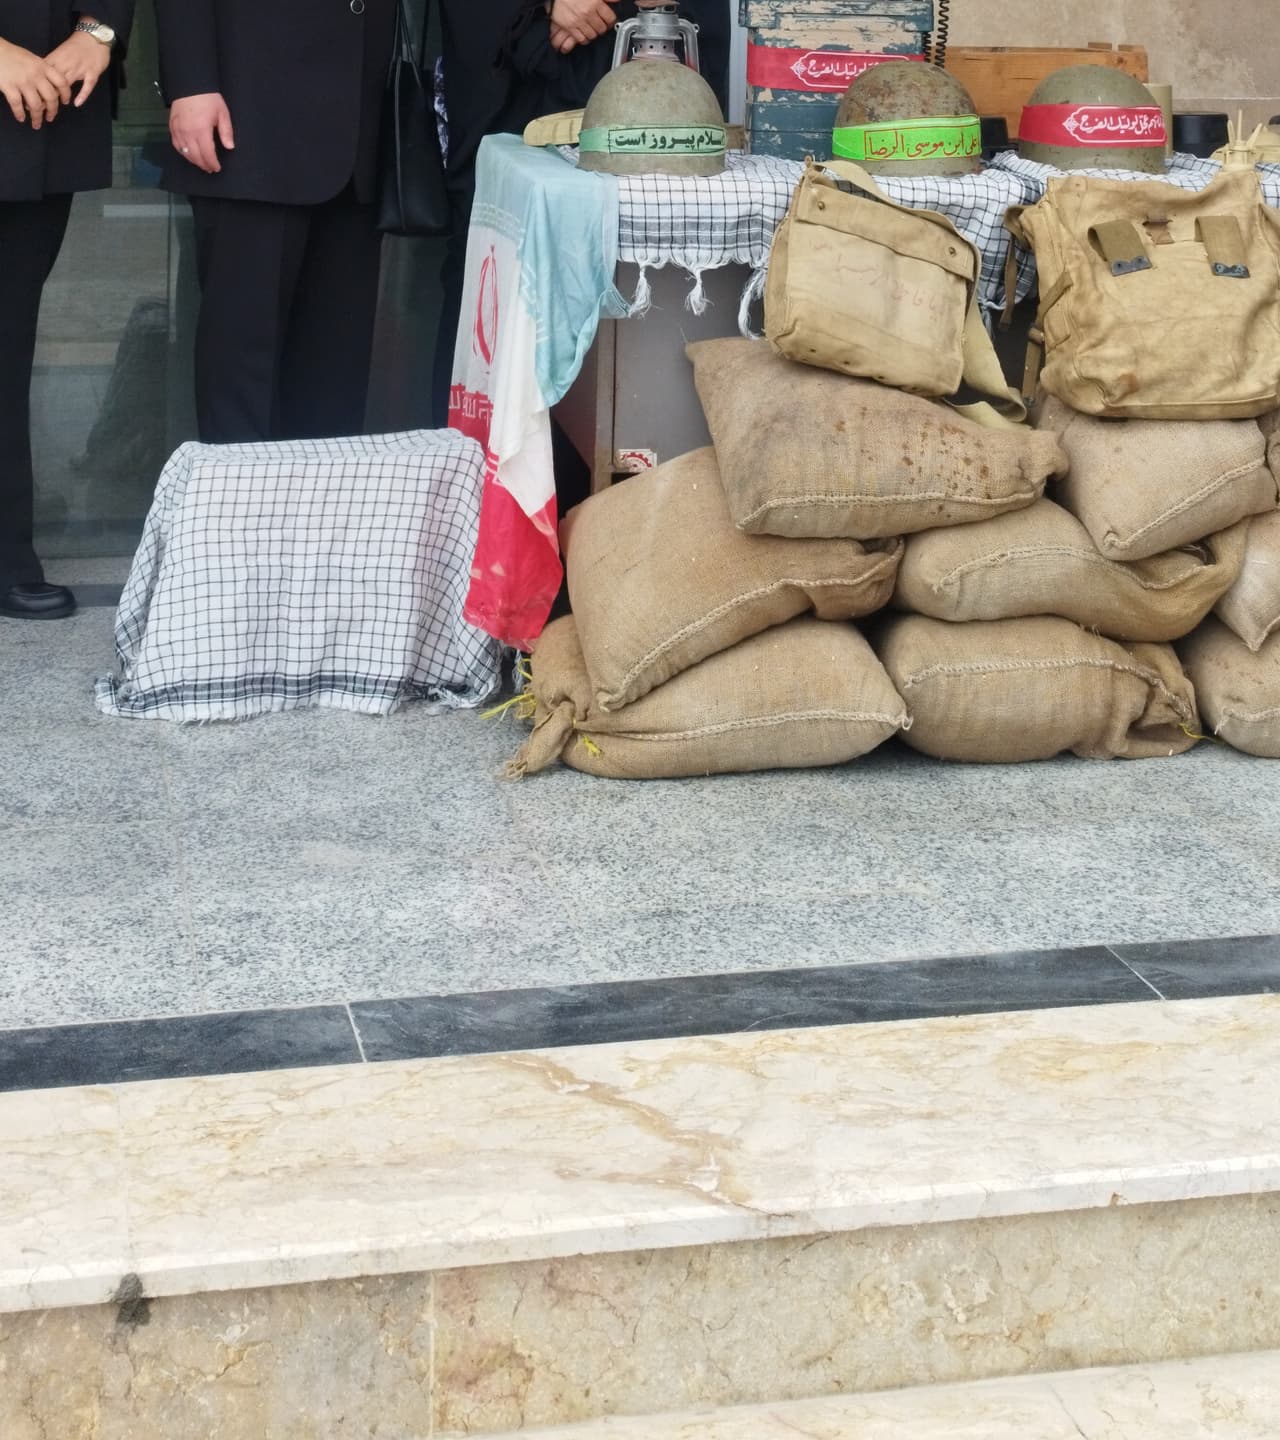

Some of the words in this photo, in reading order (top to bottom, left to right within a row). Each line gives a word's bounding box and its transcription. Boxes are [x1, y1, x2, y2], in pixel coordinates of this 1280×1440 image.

[614, 131, 647, 147] است
[649, 133, 696, 150] پیروز
[868, 130, 905, 159] الرضا
